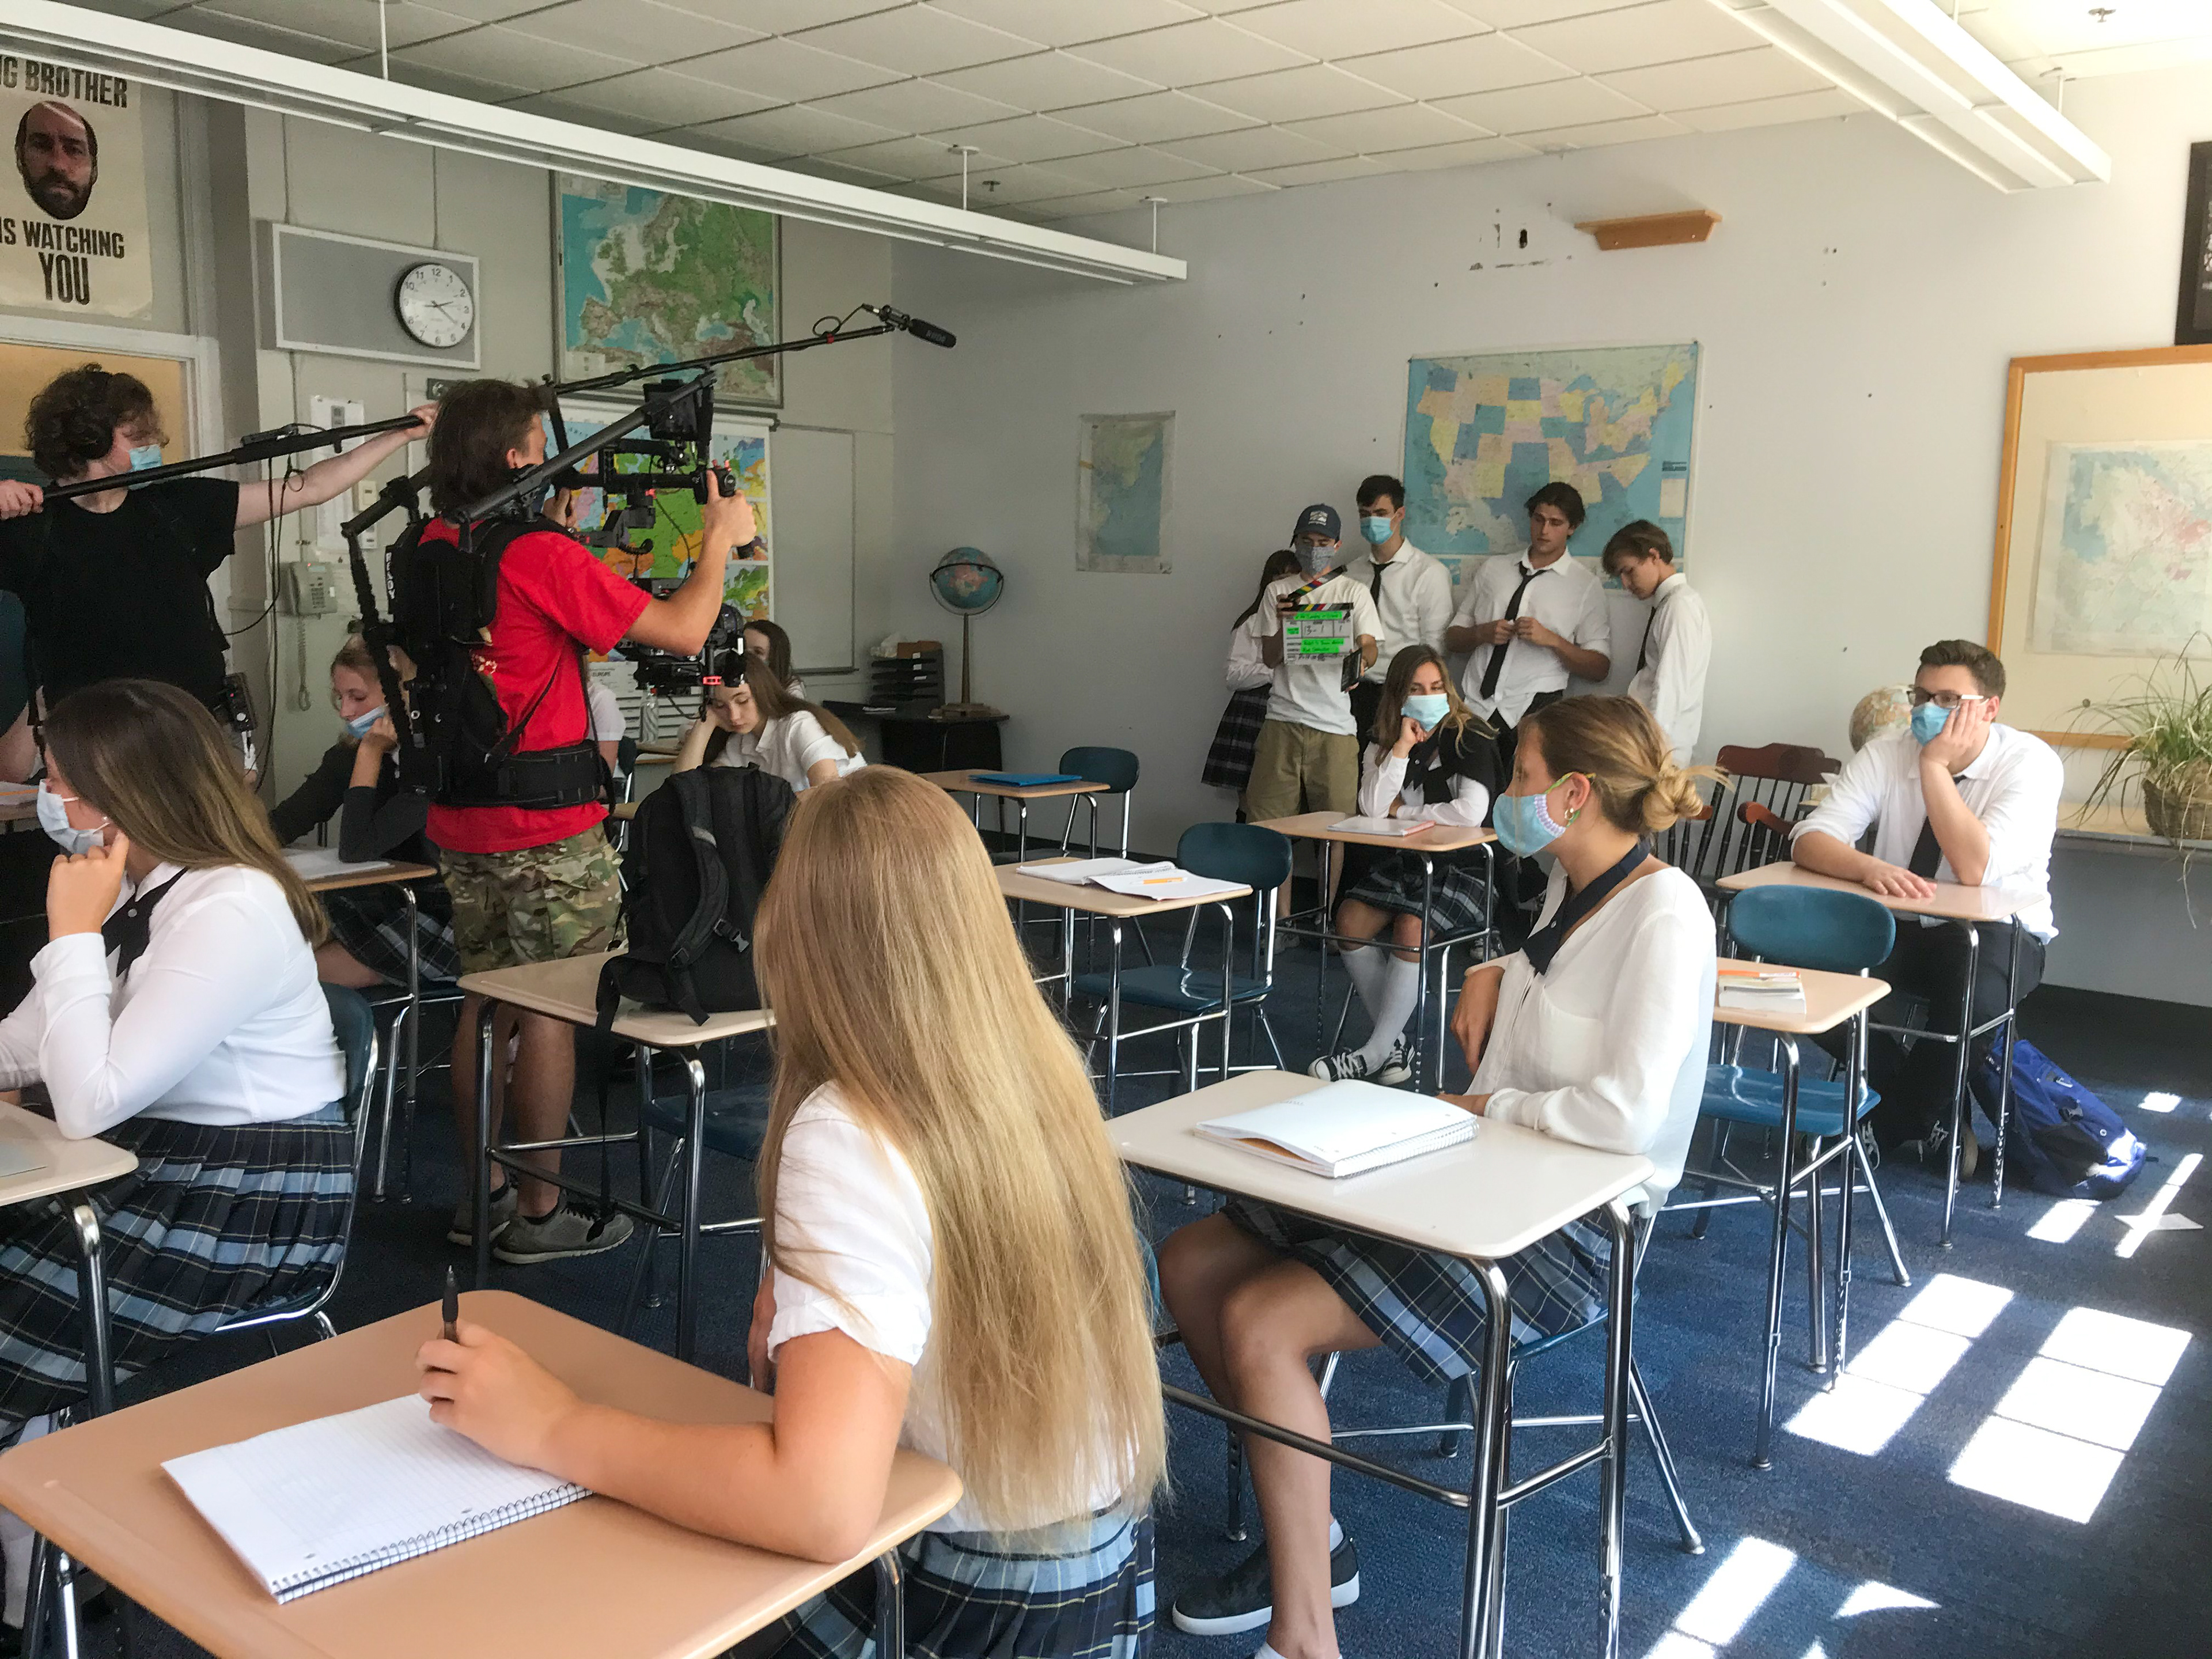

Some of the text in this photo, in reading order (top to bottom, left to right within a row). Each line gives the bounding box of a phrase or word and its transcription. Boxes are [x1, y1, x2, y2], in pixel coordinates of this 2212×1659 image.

[25, 59, 127, 108] BROTHER
[22, 219, 125, 259] WATCHING
[415, 271, 424, 279] 11
[431, 268, 441, 277] 12
[38, 251, 90, 305] YOU
[449, 275, 453, 283] 1
[405, 281, 414, 290] 10
[460, 289, 465, 297] 2
[419, 329, 425, 338] 7
